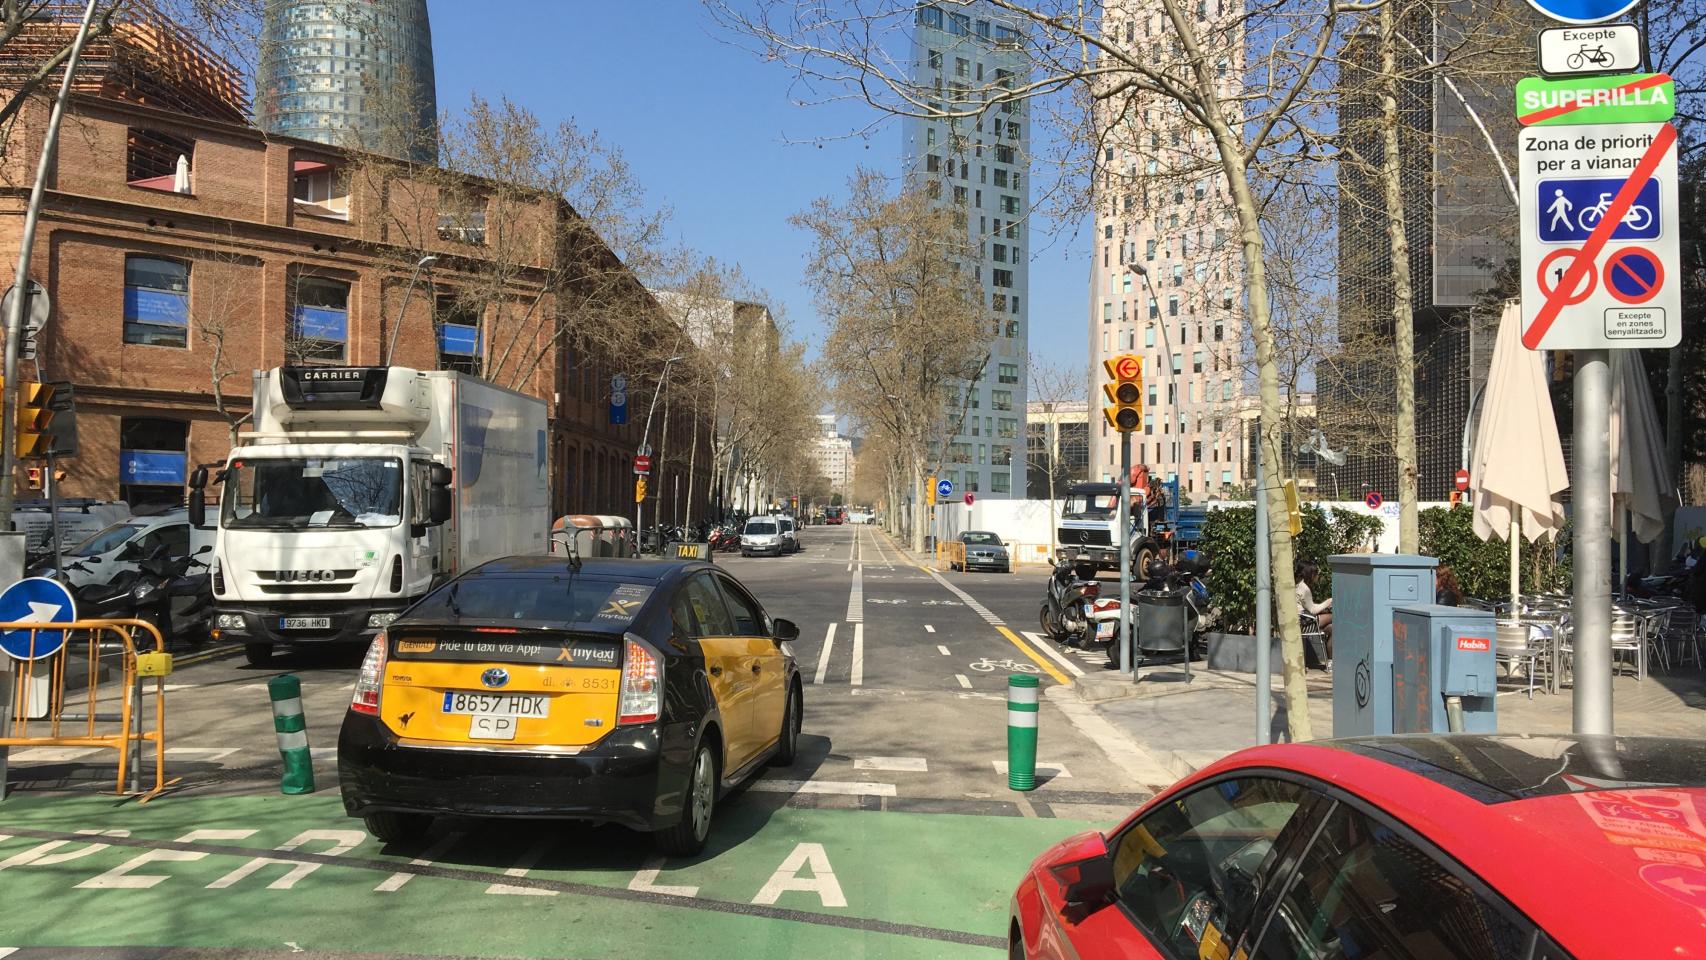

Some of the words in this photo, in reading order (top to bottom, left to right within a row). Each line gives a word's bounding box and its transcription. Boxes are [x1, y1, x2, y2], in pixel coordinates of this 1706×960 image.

[1563, 30, 1616, 42] Excepte
[1524, 87, 1668, 109] SUPERILLA
[1525, 137, 1569, 151] Zona
[1574, 136, 1596, 150] de
[1601, 133, 1654, 152] priorit
[1537, 159, 1566, 174] per
[1571, 159, 1581, 170] a
[1586, 156, 1643, 170] vianan
[1618, 312, 1652, 320] Excepte
[1607, 328, 1663, 336] senyalitzades
[304, 371, 360, 380] CARRIER
[677, 545, 698, 558] TAXI
[275, 569, 336, 582] IVECO
[286, 618, 307, 628] 9736
[597, 613, 634, 621] mytaxi
[439, 640, 461, 651] Pide
[464, 641, 474, 652] tu
[477, 641, 496, 652] taxi
[516, 643, 541, 656] App!
[573, 647, 615, 660] mytaxi
[582, 678, 615, 689] 8531
[455, 694, 503, 714] 8657
[508, 696, 543, 715] HDK
[0, 829, 853, 907] PERILLA
